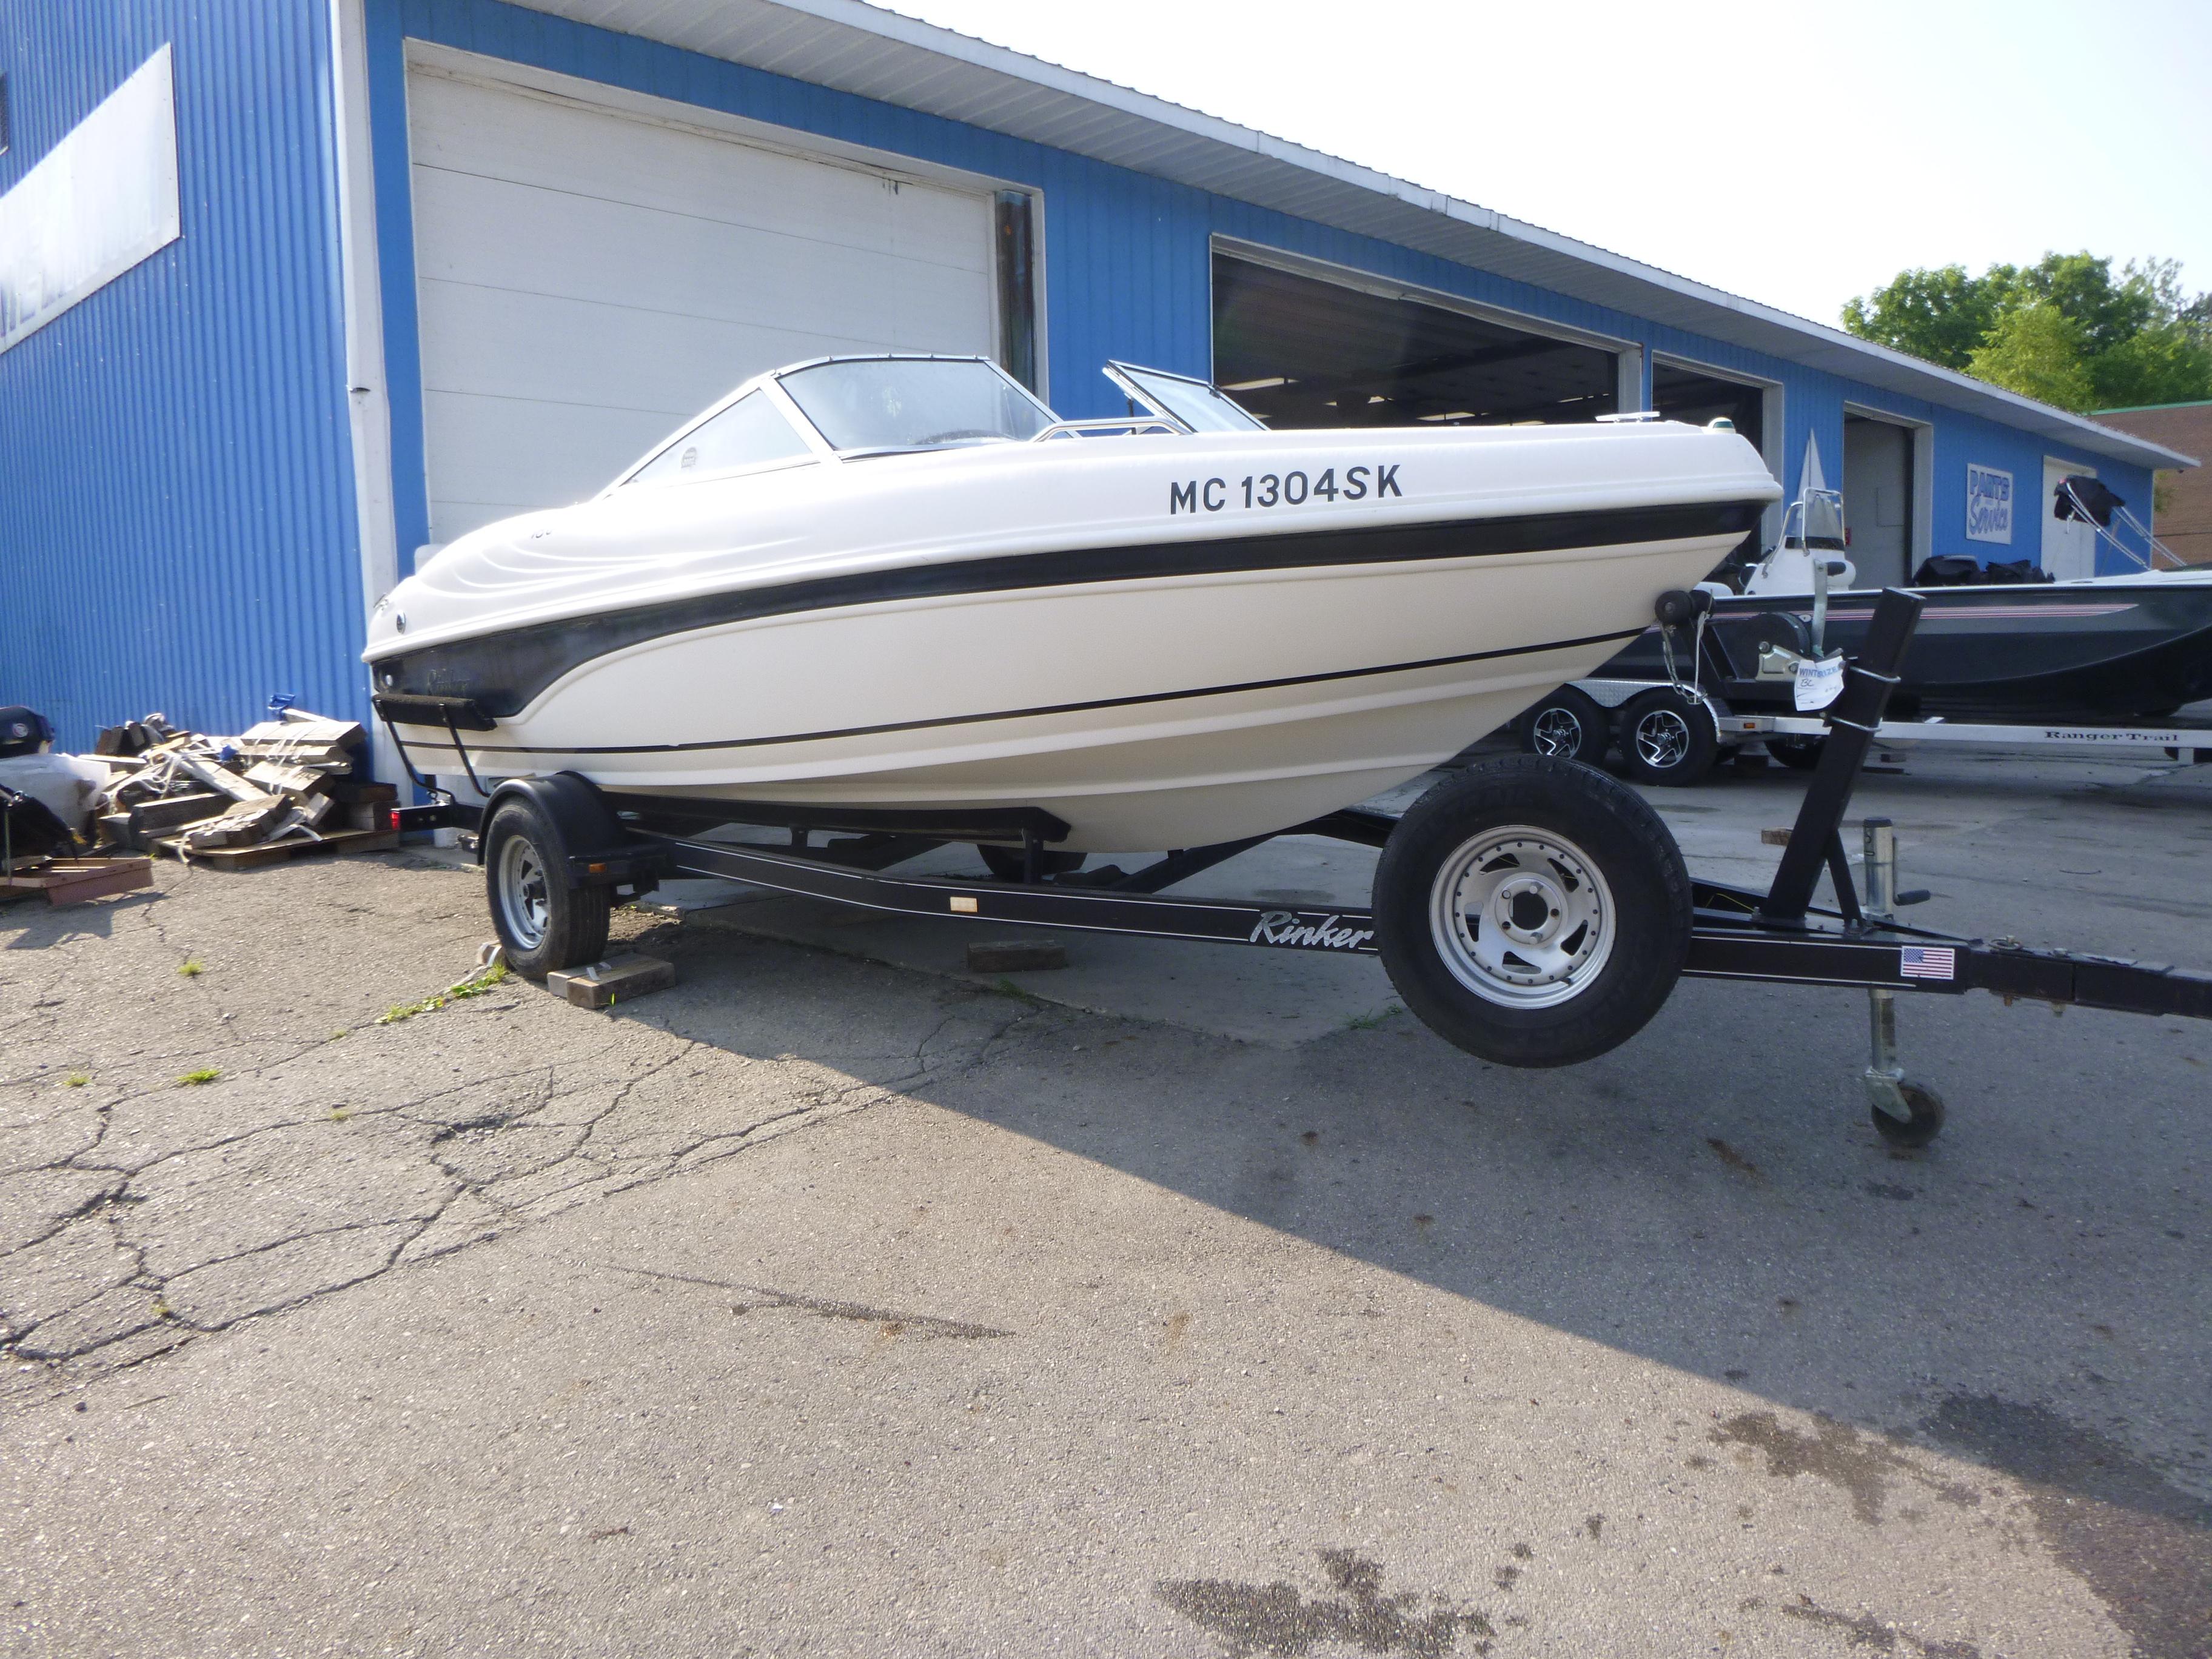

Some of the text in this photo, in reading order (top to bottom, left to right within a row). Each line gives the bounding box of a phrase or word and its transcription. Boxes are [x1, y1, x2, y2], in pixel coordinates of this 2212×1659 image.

[1170, 465, 1402, 514] MC 1304SK
[1969, 470, 2009, 501] PARTS
[1969, 496, 2008, 535] Service
[2044, 731, 2178, 742] Ranger Trail
[1250, 911, 1374, 948] Rinker
